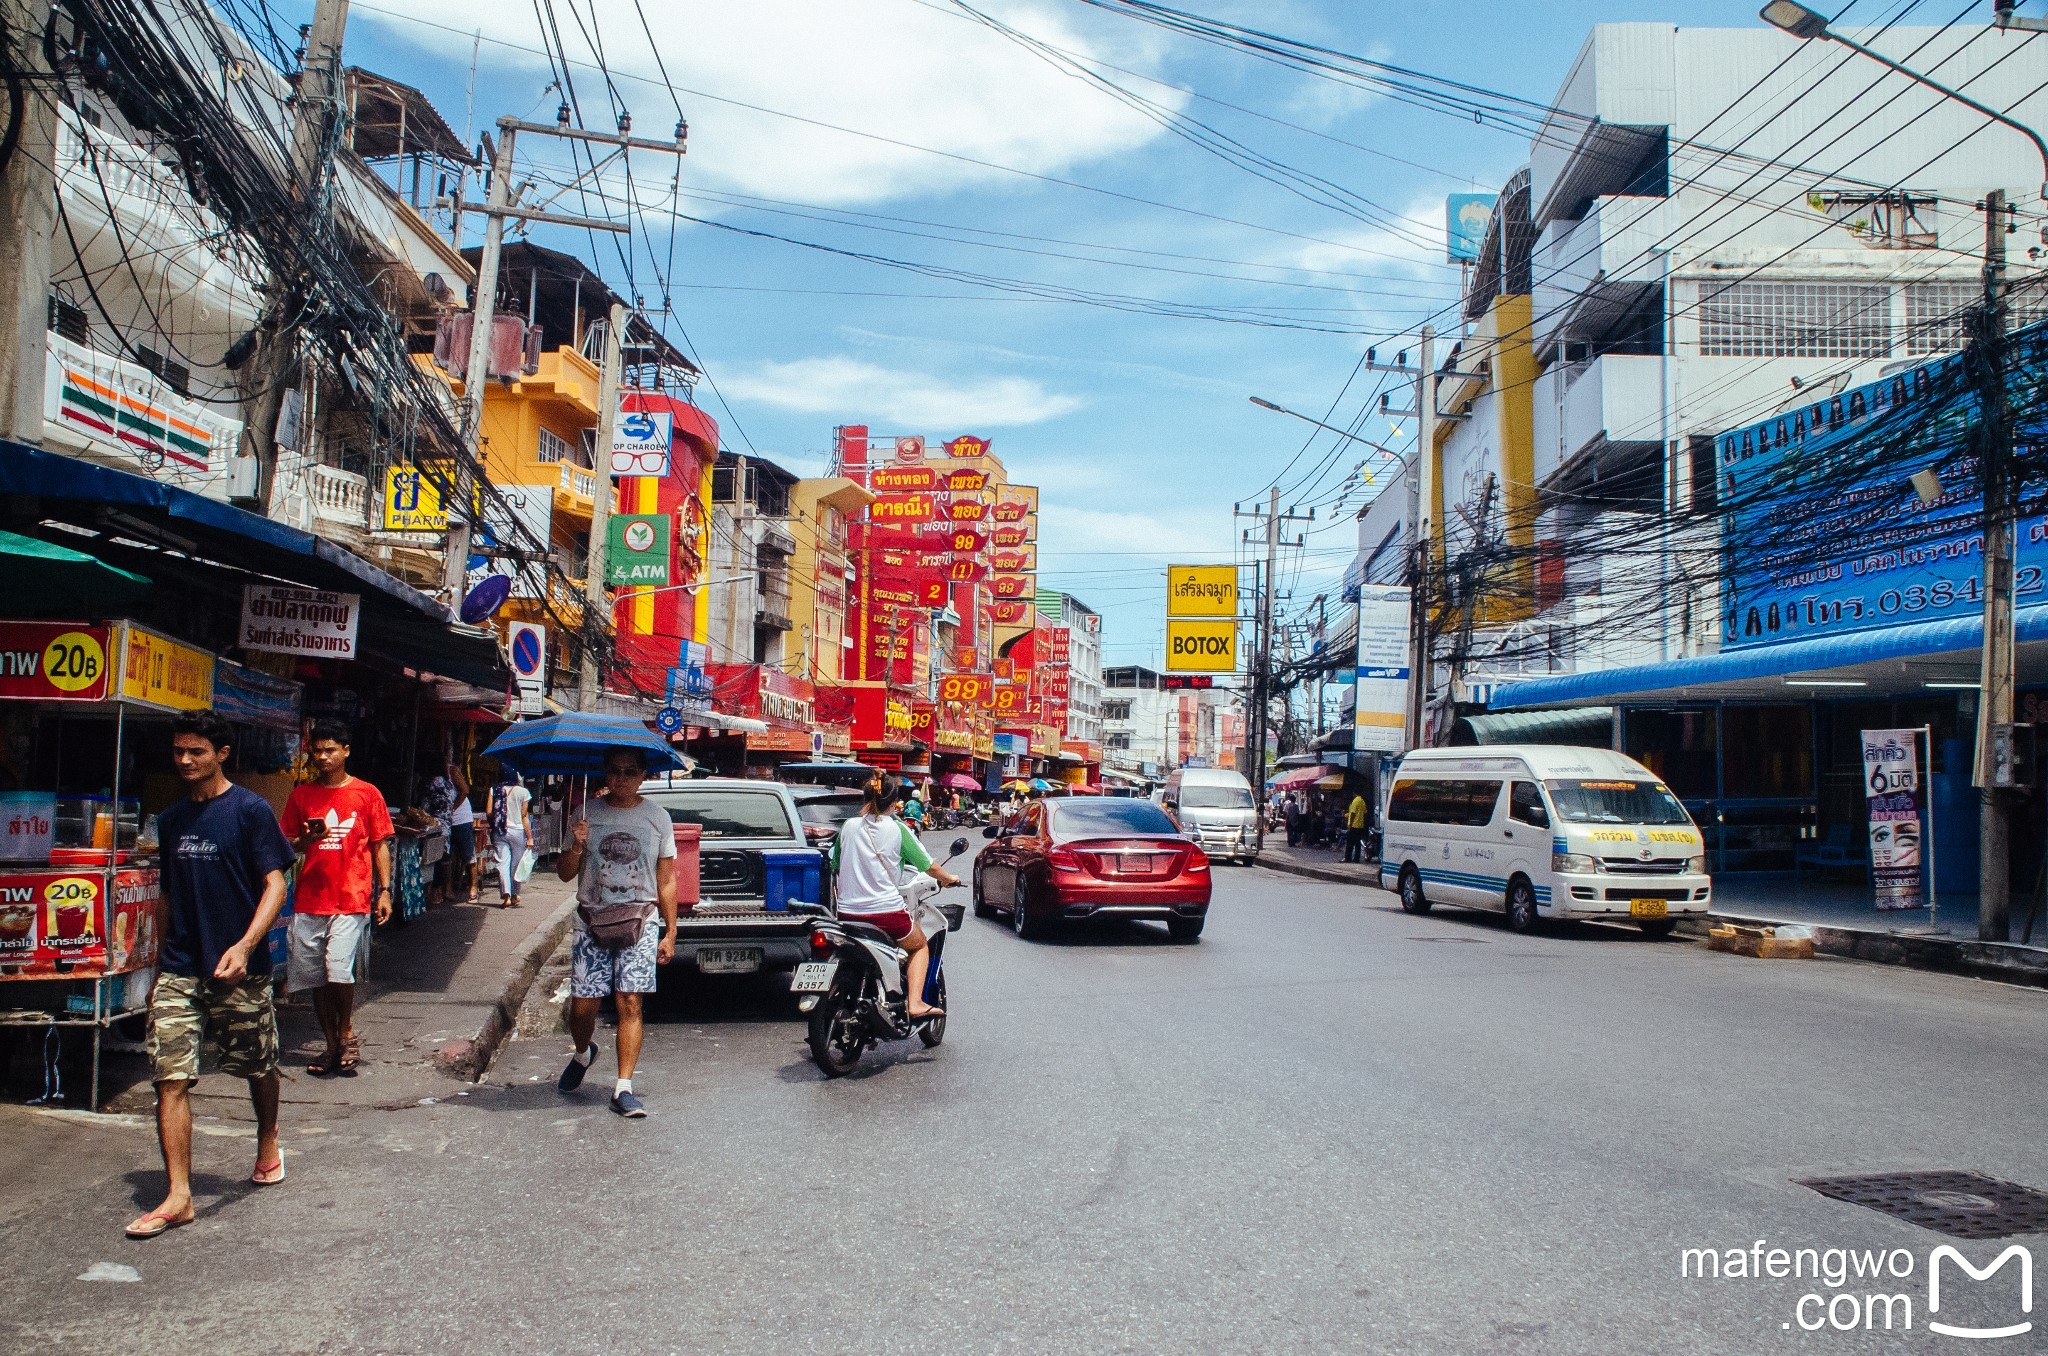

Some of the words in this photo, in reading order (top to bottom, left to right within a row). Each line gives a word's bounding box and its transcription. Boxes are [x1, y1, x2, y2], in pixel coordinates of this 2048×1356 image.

[953, 437, 981, 456] ห้าง
[875, 471, 930, 486] ห้างทอง
[950, 475, 984, 489] เพชร
[952, 504, 981, 519] ทอง
[996, 505, 1018, 519] ห้าง
[954, 534, 975, 550] 99
[630, 565, 665, 579] ATM
[951, 562, 974, 580] (1)
[927, 584, 941, 599] 2
[998, 582, 1014, 593] 99
[1174, 576, 1232, 605] เสริมจมูก
[250, 594, 349, 631] ยำปลาดุกฟู
[996, 606, 1014, 618] (2)
[1173, 636, 1230, 655] BOTOX
[944, 680, 979, 699] 99
[1865, 738, 1906, 762] สักคิ้ว
[1870, 764, 1888, 793] 6
[1889, 769, 1913, 788] มิติ
[8, 815, 48, 836] ลำไย
[1594, 830, 1632, 842] รถร่วม
[797, 981, 825, 990] 8357
